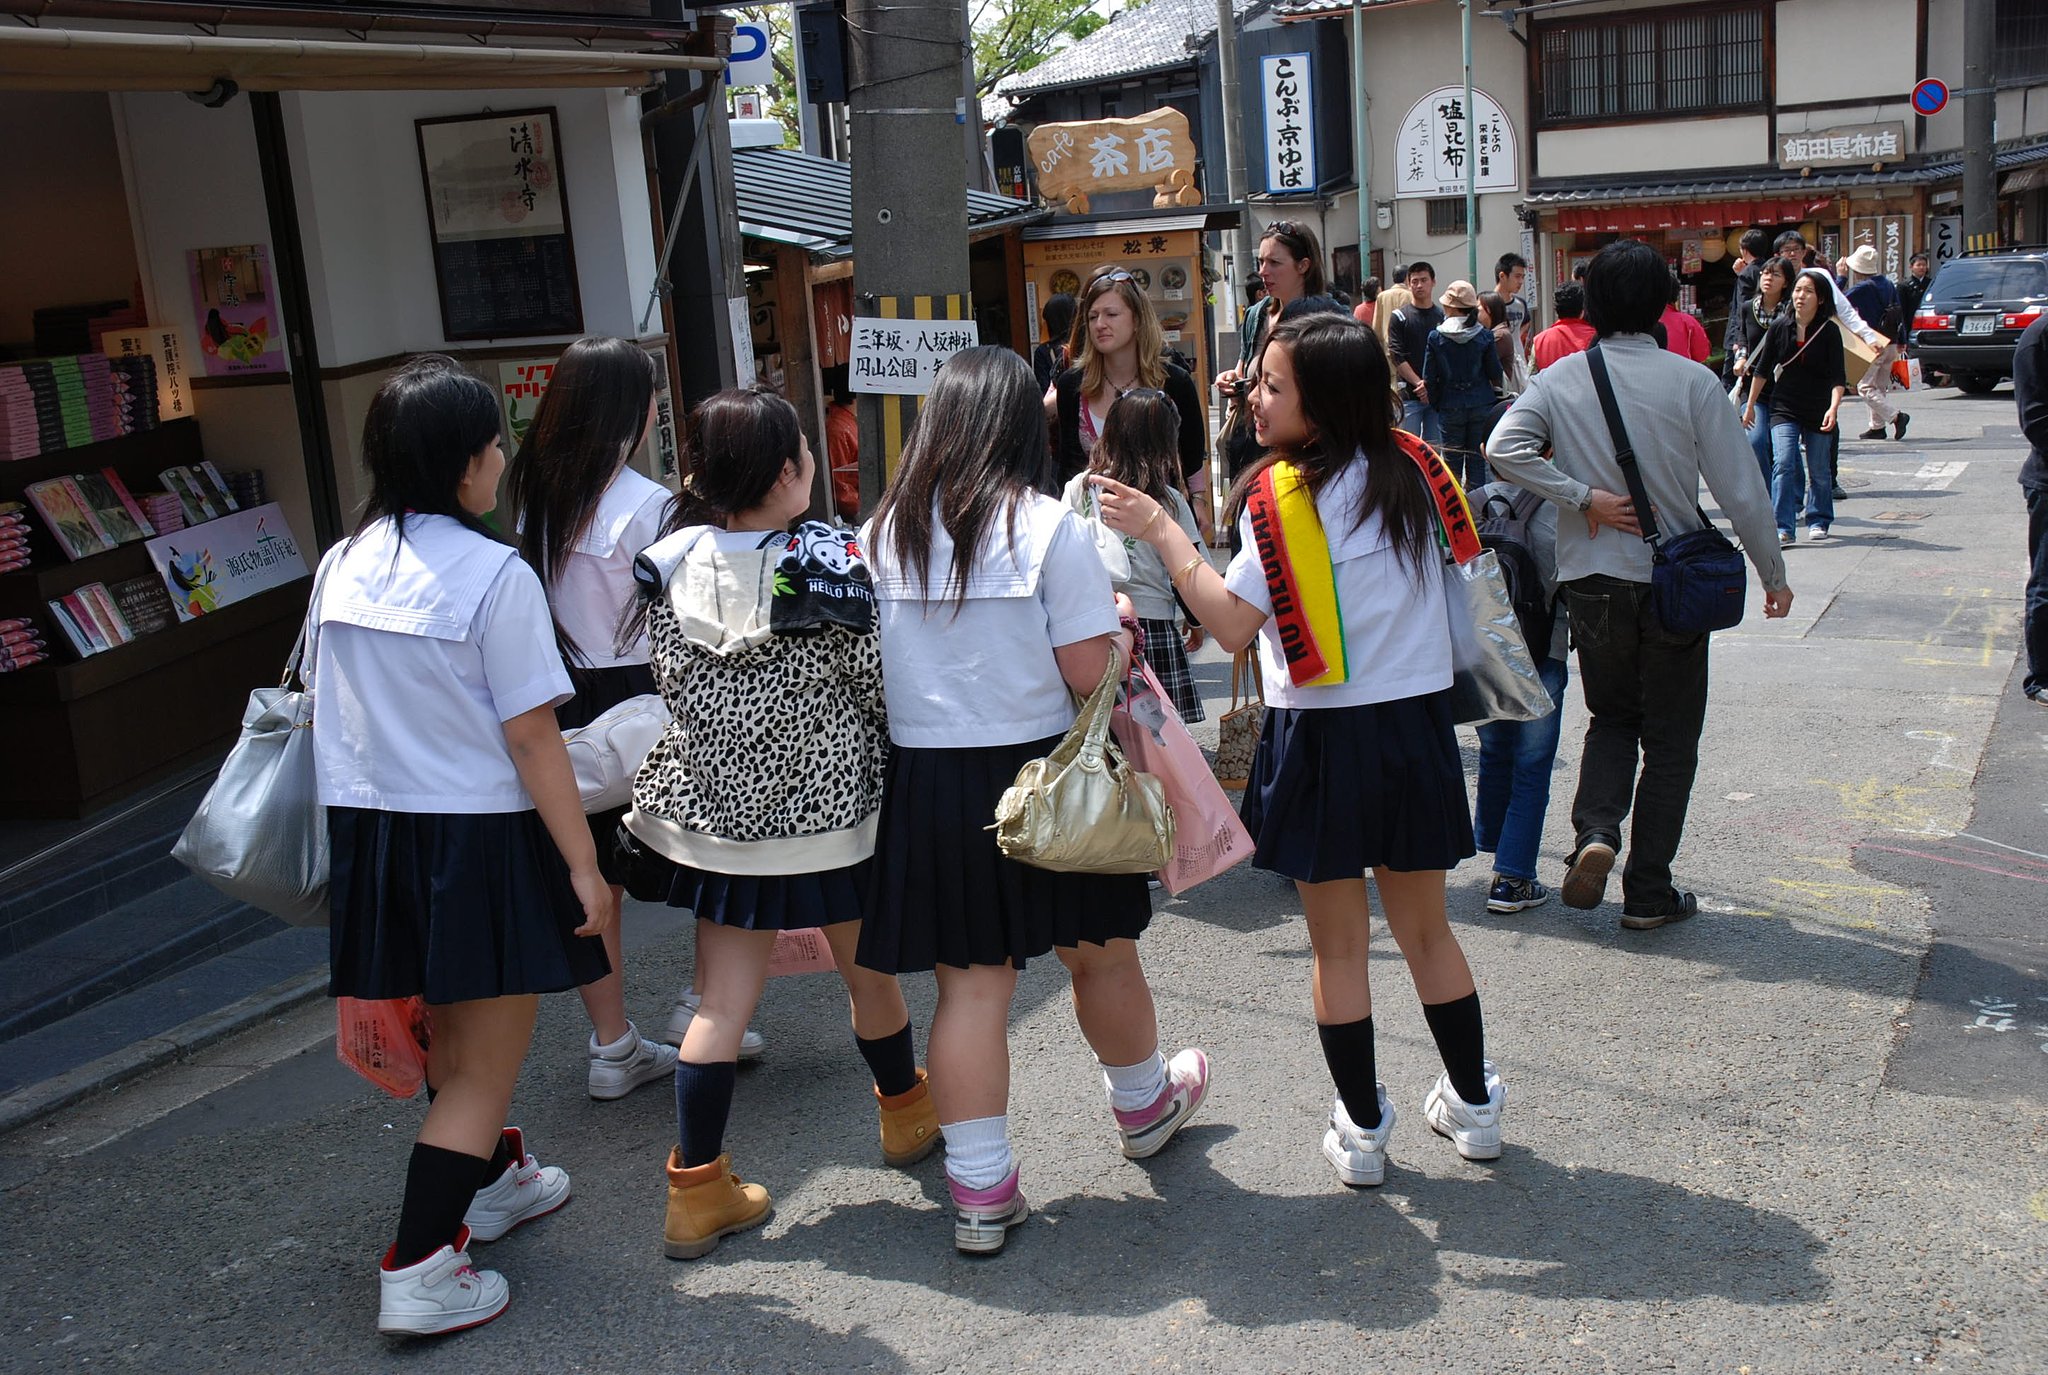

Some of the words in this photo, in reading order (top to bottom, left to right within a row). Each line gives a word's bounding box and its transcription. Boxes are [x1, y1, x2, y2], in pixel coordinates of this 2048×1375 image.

[1276, 59, 1304, 187] こんぶ・京ゆば
[1438, 98, 1467, 178] 塩昆布
[1491, 113, 1501, 153] こんぶの
[510, 123, 537, 212] 清水寺
[1089, 128, 1174, 178] 茶店
[1783, 131, 1898, 163] 飯田昆布店
[1438, 186, 1467, 194] 飯田昆布
[1122, 236, 1168, 255] 松葉
[1937, 223, 1953, 265] こん
[1417, 444, 1444, 478] NO
[809, 581, 843, 598] HELLO
[1279, 622, 1309, 664] NO
